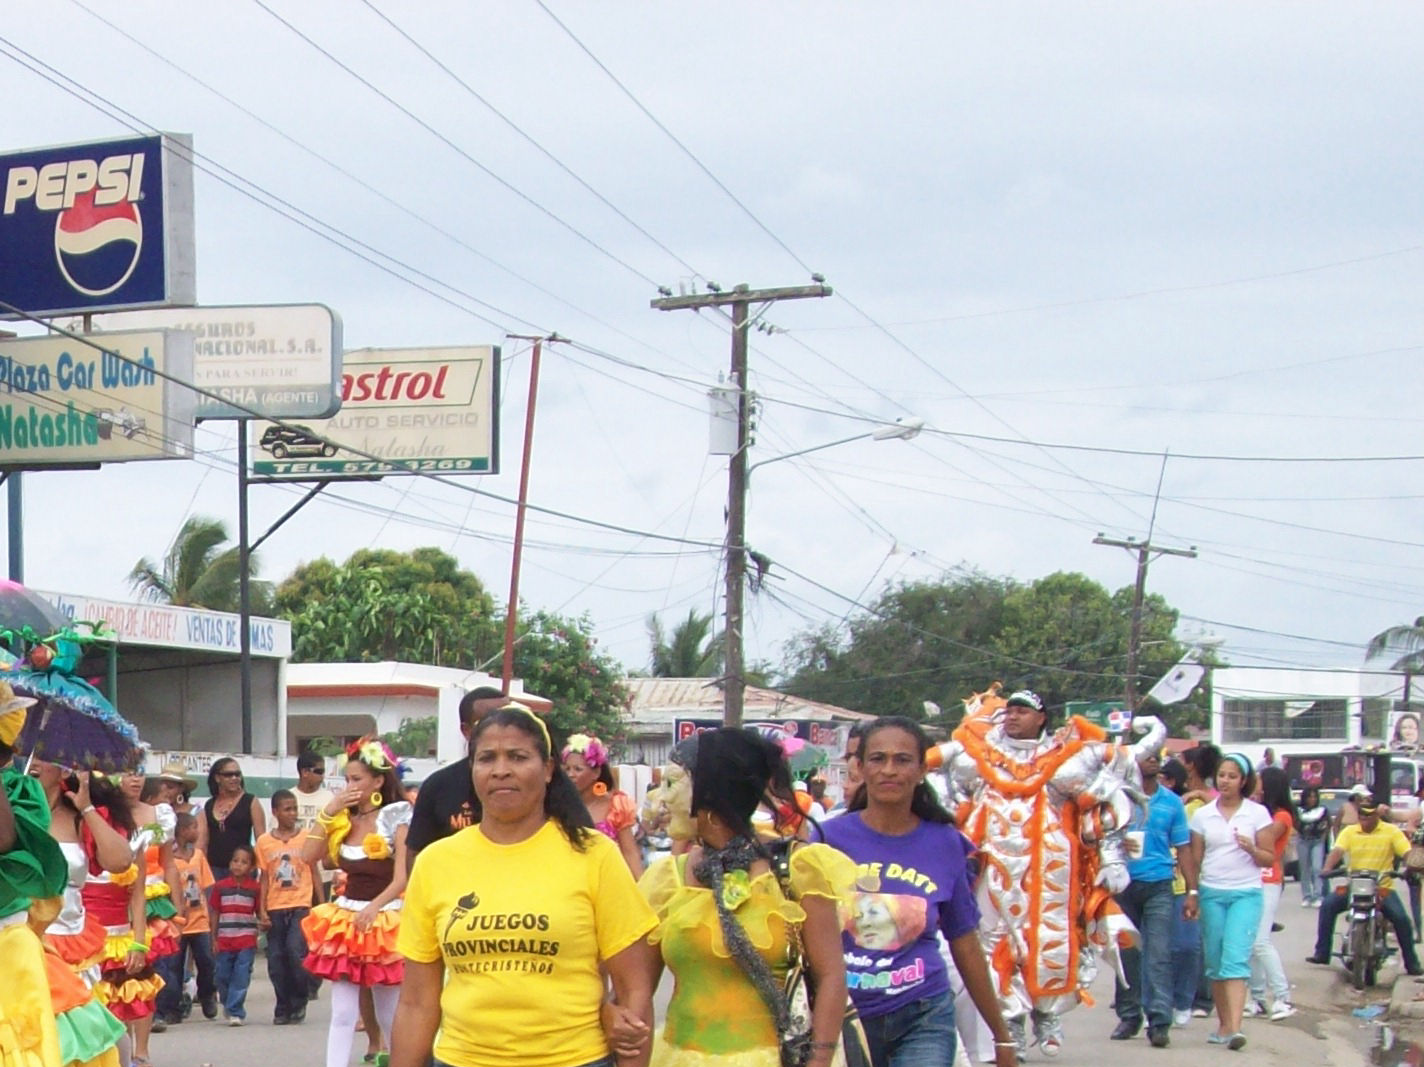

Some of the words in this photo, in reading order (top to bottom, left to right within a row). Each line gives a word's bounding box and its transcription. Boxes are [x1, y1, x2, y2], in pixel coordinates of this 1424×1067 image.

[4, 153, 145, 214] PEPSI
[56, 351, 95, 391] Car
[101, 347, 155, 389] Wash
[205, 367, 241, 379] PARA
[342, 364, 449, 402] astrol
[200, 387, 258, 406] TASHA
[262, 391, 320, 404] (AGENTE)
[326, 414, 376, 430] AUTO
[387, 412, 479, 428] SERVICIO
[273, 462, 331, 473] TEL.
[186, 615, 223, 648] VENTAS
[226, 619, 237, 648] DE
[250, 621, 274, 651] MAS
[466, 913, 549, 931] JUEGOS
[443, 938, 560, 958] PROVINCIALES
[845, 957, 924, 990] rnaval
